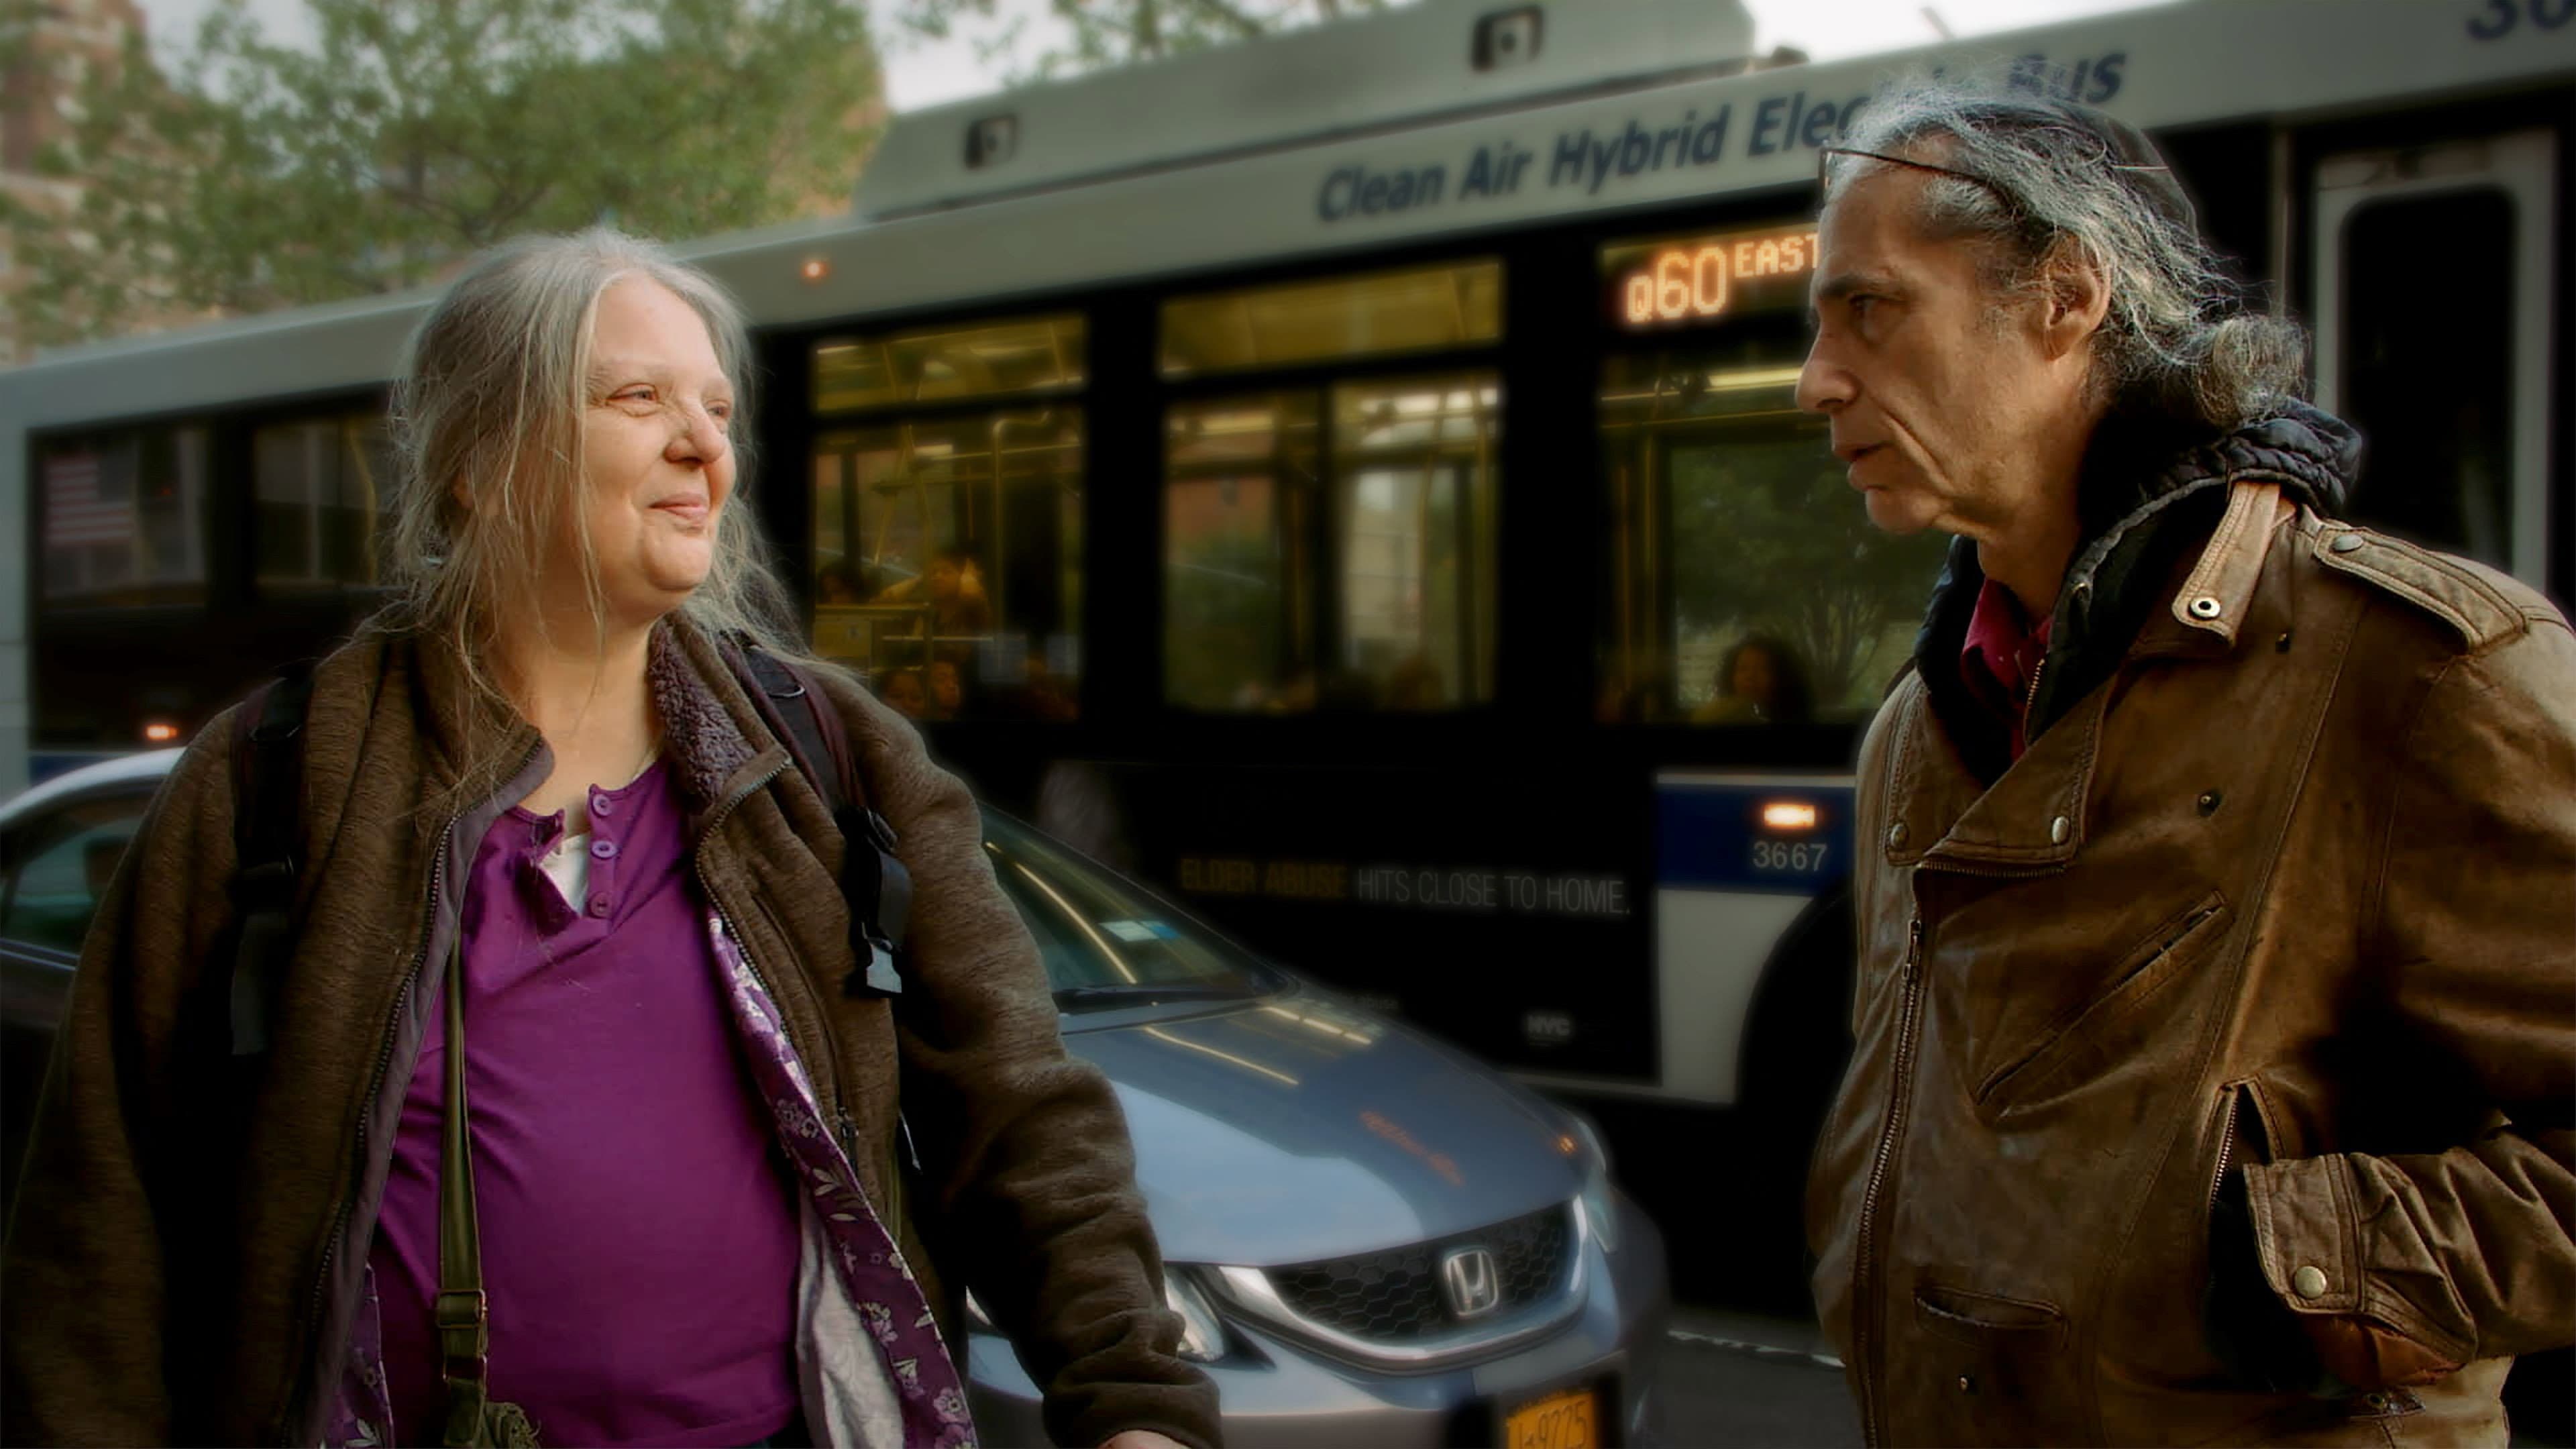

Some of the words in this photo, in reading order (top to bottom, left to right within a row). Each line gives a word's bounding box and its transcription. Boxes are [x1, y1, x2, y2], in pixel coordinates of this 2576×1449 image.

[1318, 163, 1447, 222] Clean
[1458, 140, 1534, 201] Air
[1547, 104, 1732, 195] Hybrid
[1627, 246, 1727, 323] Q60
[1752, 841, 1827, 872] 3667
[1181, 859, 1257, 892] ELDER
[1265, 863, 1348, 900] ABUSE
[1358, 868, 1410, 903] HITS
[1418, 871, 1497, 909] CLOSE
[1505, 875, 1538, 909] TO
[1546, 877, 1633, 917] HOME.
[1526, 1015, 1570, 1037] NYC
